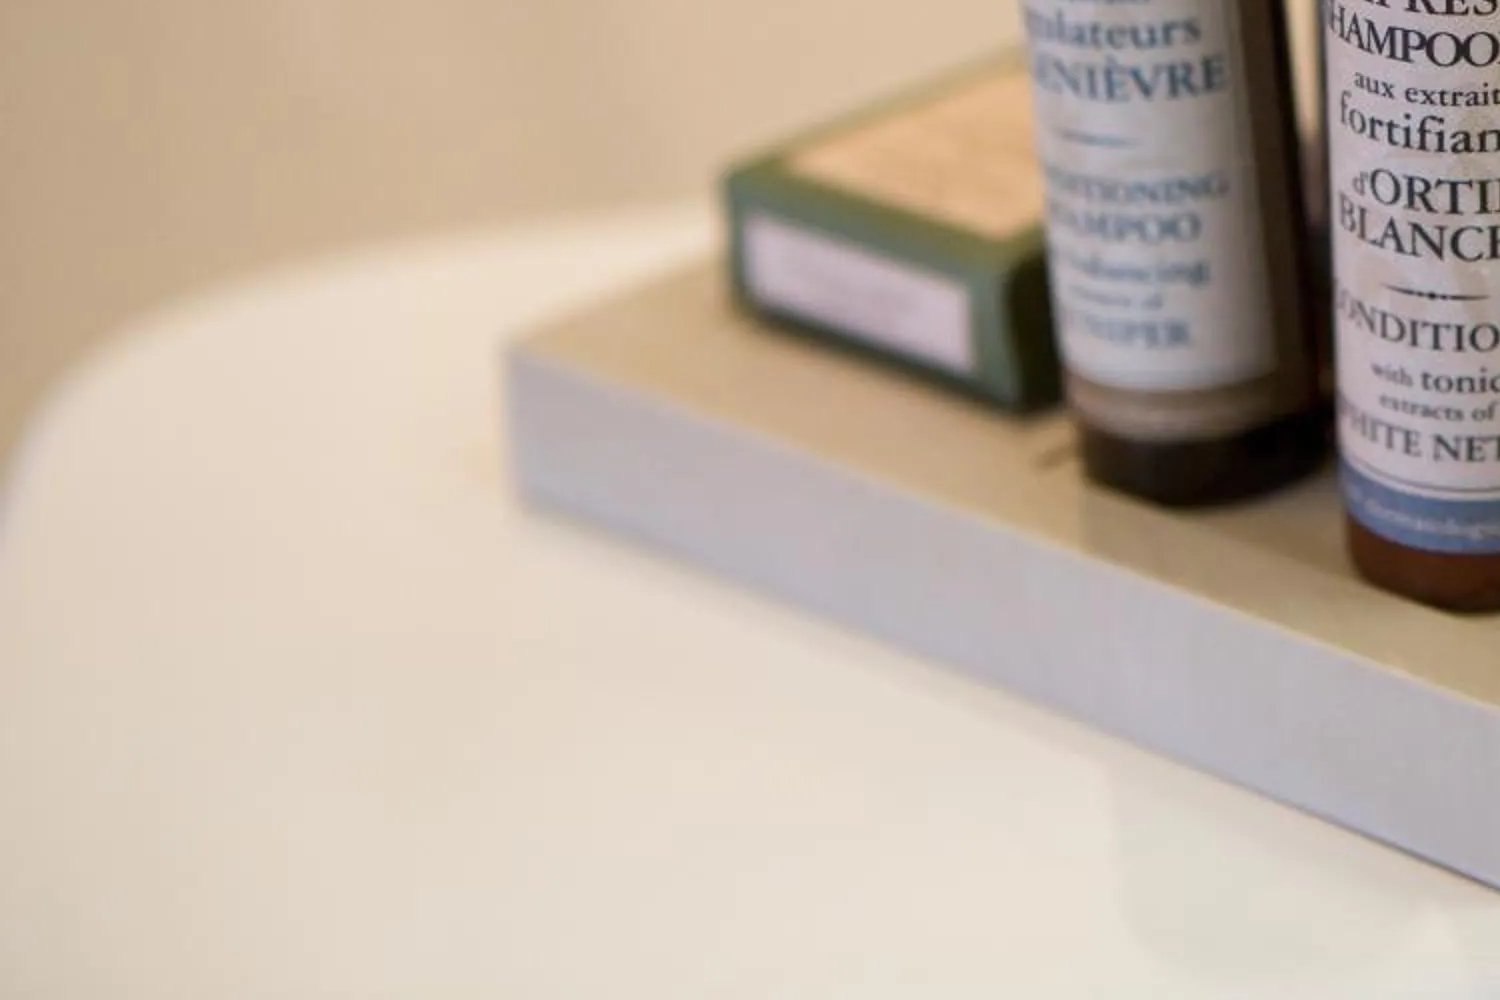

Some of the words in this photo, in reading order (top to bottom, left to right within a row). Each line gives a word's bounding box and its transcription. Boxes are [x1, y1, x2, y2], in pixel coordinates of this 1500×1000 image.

[1353, 71, 1396, 100] aux
[1370, 361, 1413, 388] with
[1379, 392, 1464, 422] extracts
[1471, 400, 1499, 423] of
[1341, 402, 1422, 457] HITE
